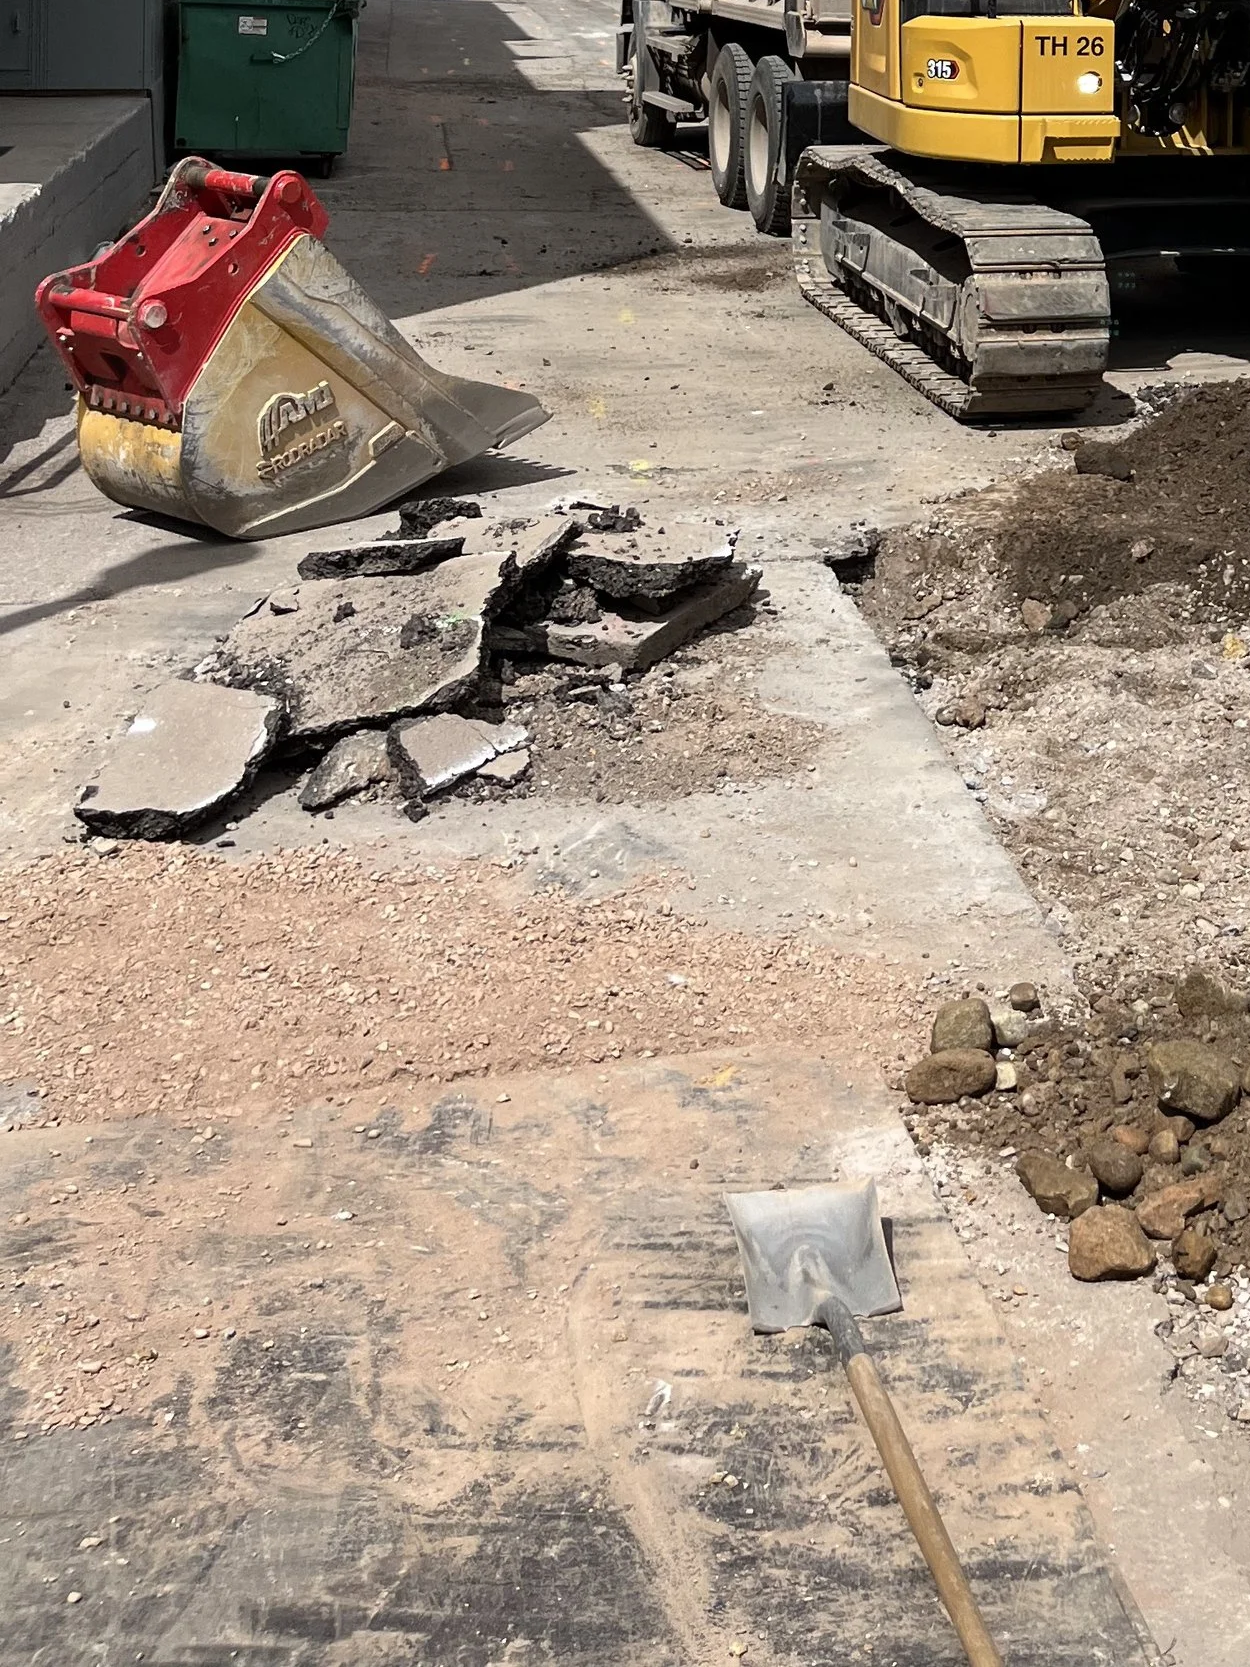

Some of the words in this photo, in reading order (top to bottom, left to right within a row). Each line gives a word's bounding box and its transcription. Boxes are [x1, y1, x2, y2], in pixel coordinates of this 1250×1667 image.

[1034, 36, 1068, 56] TH
[1076, 36, 1104, 57] 26
[927, 58, 952, 79] 315
